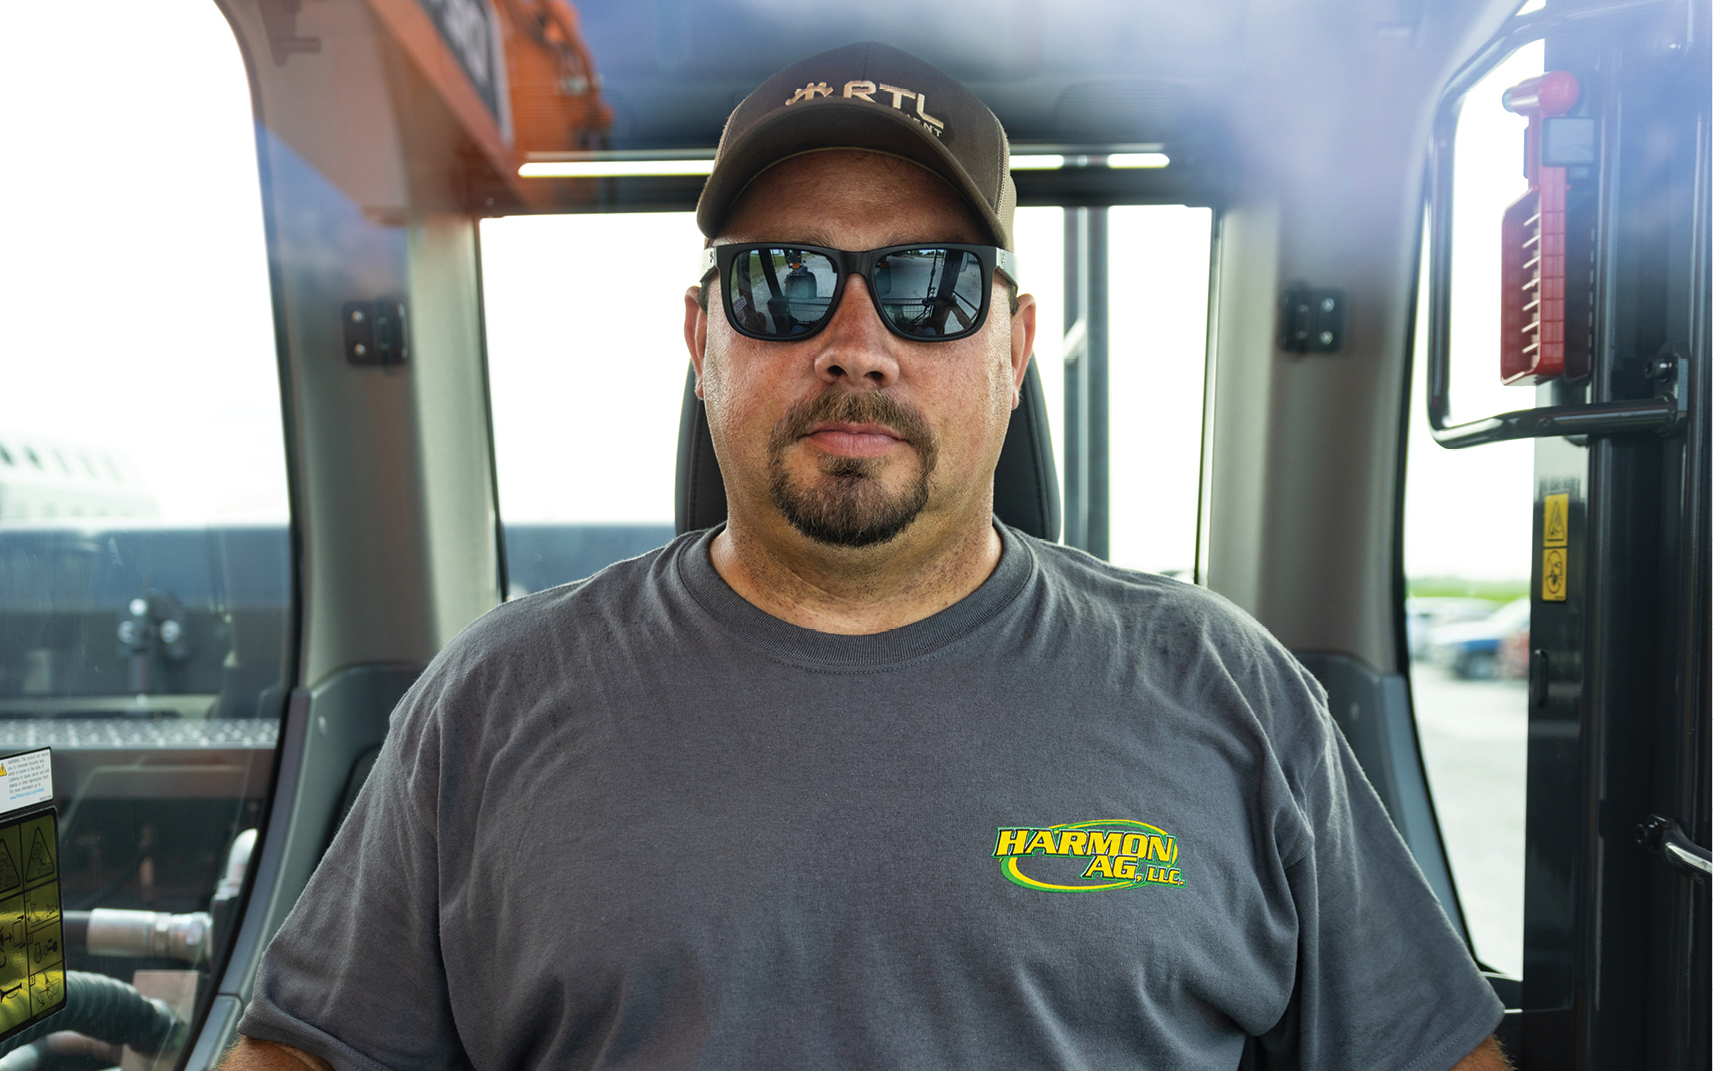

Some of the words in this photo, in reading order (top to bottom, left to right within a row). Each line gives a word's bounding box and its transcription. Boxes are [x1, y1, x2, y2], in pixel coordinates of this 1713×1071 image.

[843, 80, 944, 130] RTL
[907, 114, 942, 137] NT
[993, 828, 1176, 862] HARMON
[1082, 854, 1143, 882] AG,
[1146, 866, 1185, 885] LLC.
